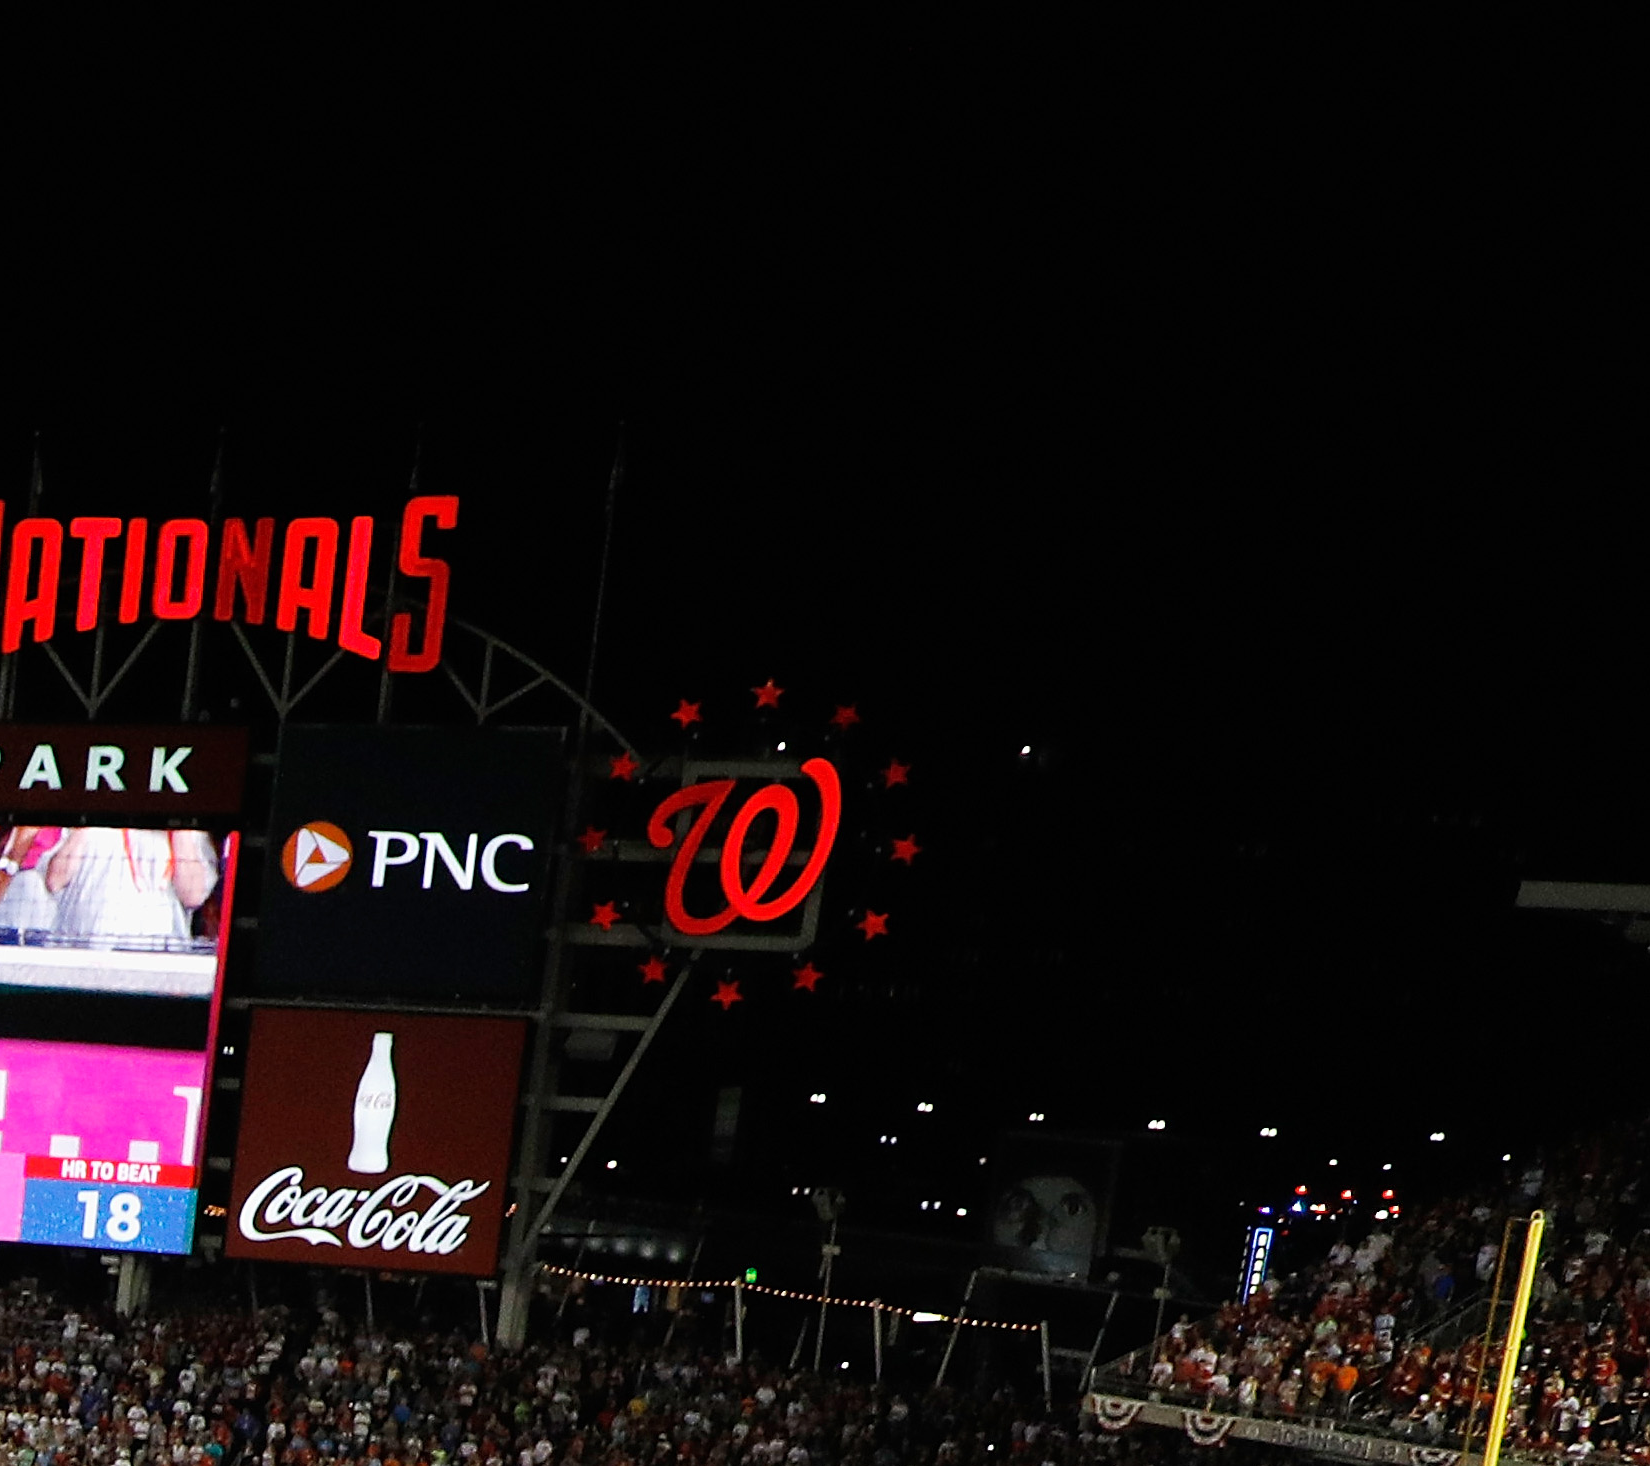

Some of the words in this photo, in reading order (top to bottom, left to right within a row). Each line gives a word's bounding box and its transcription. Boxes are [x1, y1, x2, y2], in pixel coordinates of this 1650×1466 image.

[367, 830, 536, 894] PNC
[60, 1160, 84, 1181] HR
[88, 1161, 112, 1182] TO
[116, 1163, 162, 1186] BEAT
[75, 1190, 144, 1244] 18
[237, 1165, 492, 1256] Coca-Cola
